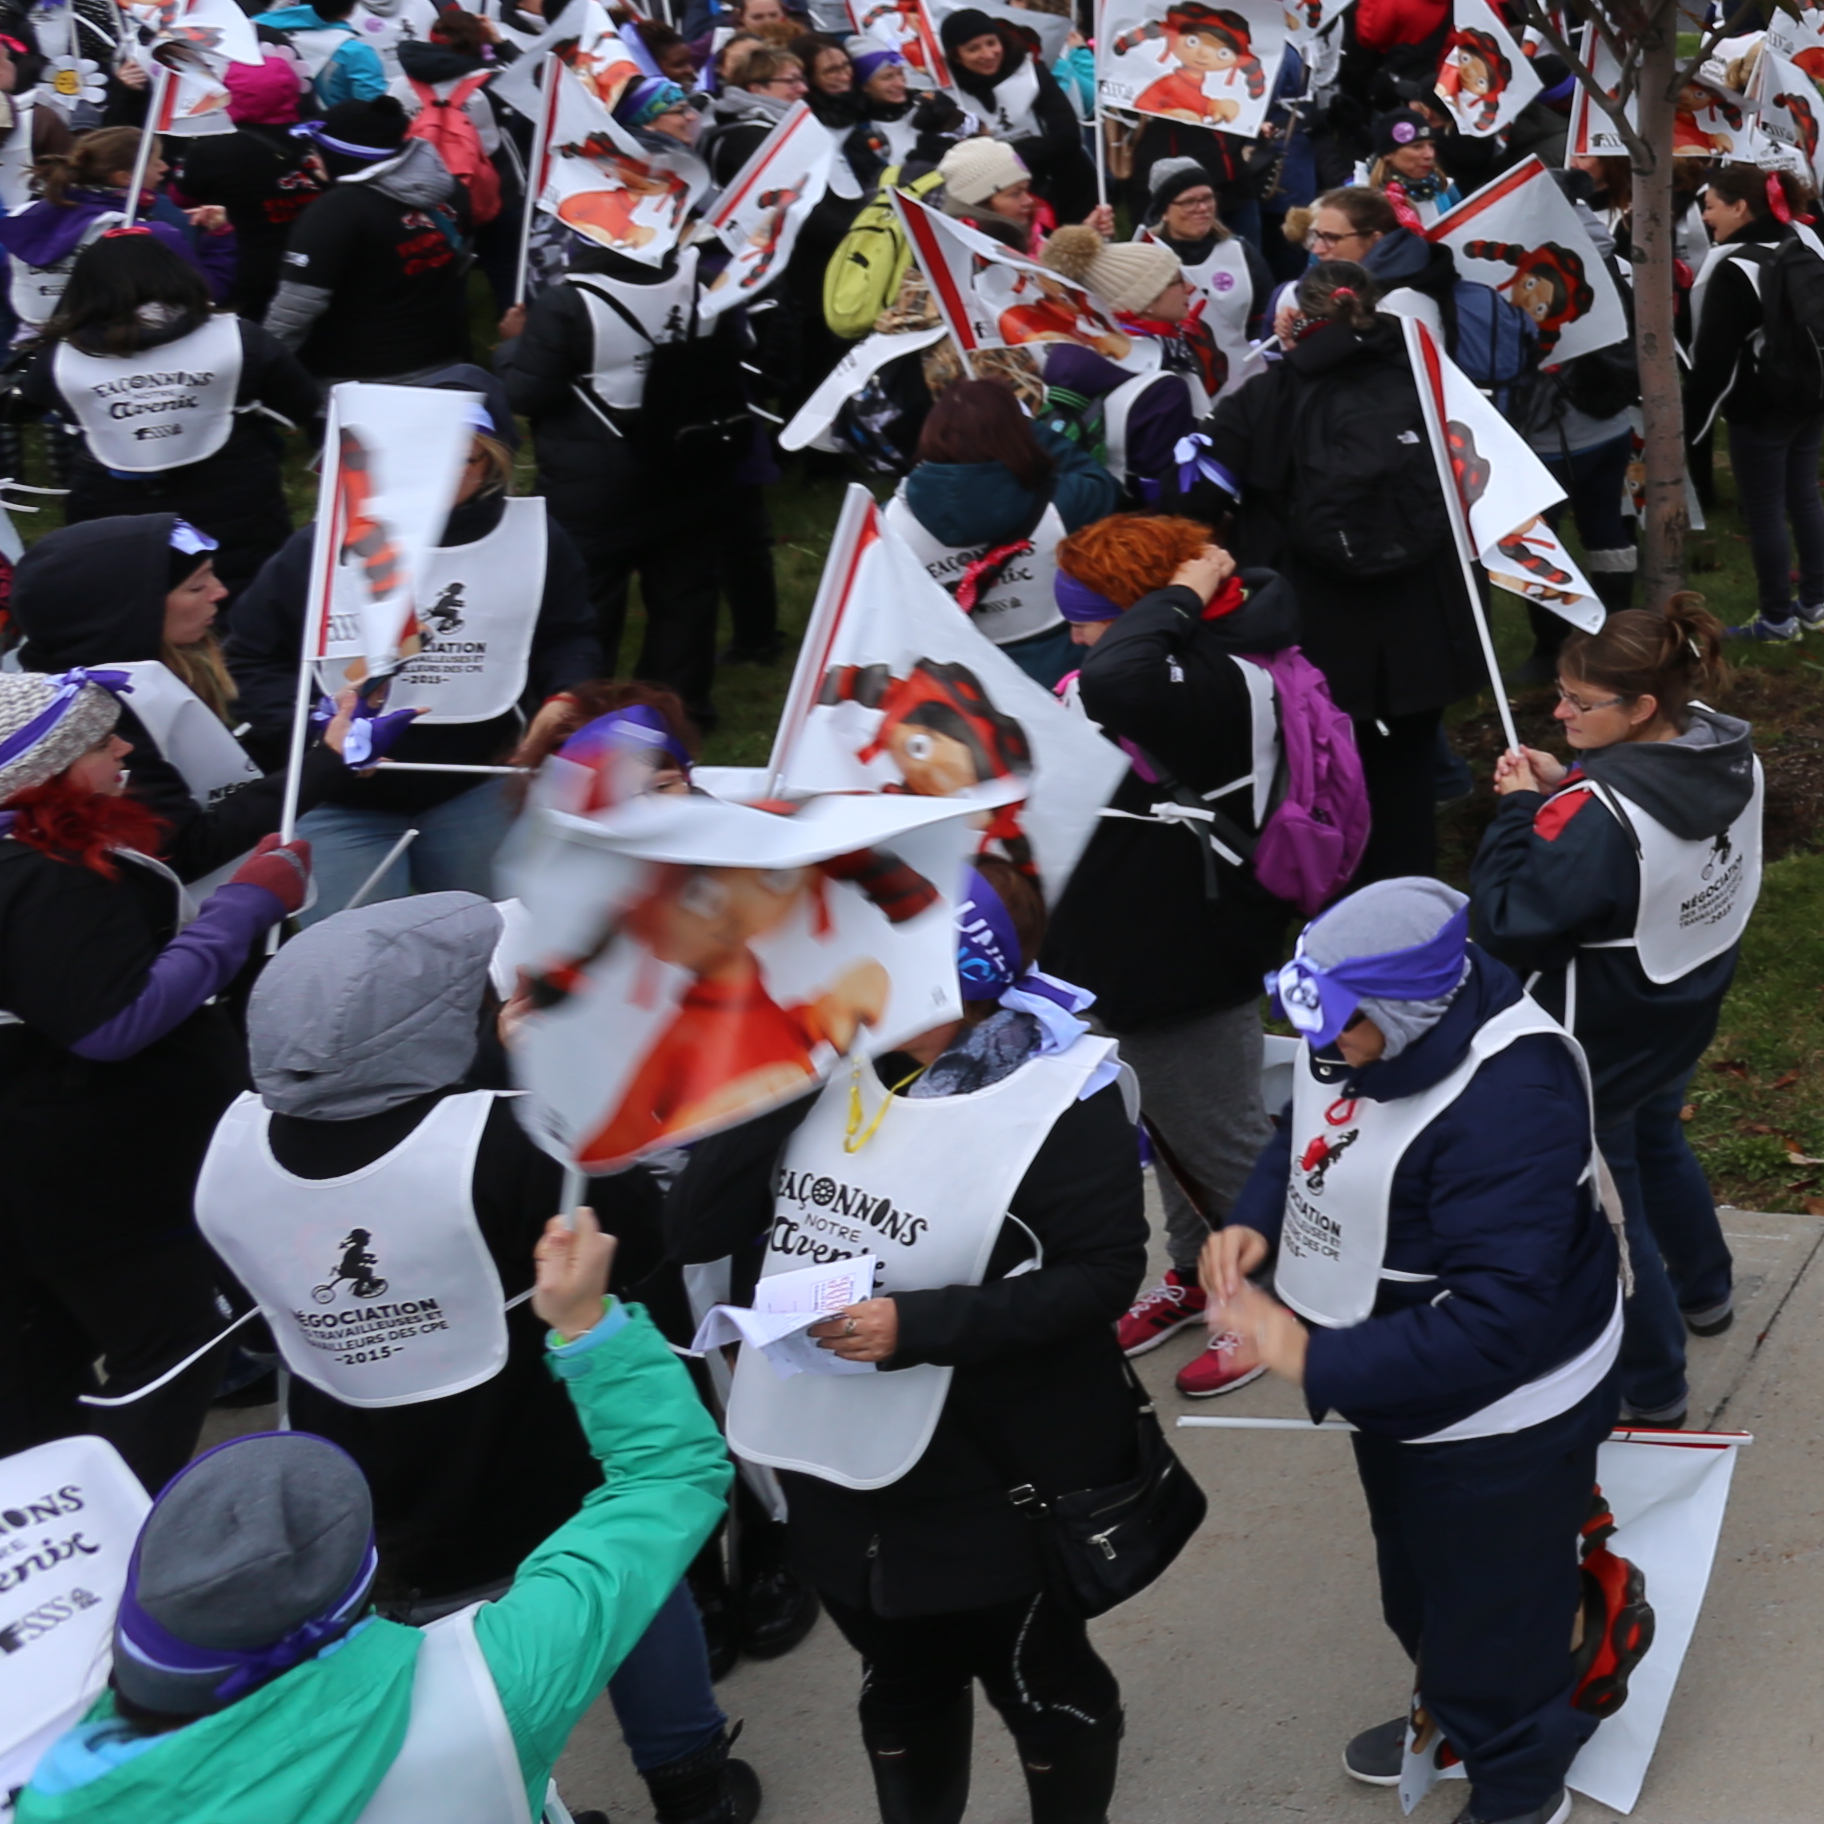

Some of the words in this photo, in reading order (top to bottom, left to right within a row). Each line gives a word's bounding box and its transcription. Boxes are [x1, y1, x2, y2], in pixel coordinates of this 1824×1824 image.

[804, 1213, 861, 1244] NOTRE
[425, 1309, 445, 1320] ET
[388, 1326, 417, 1341] DES
[420, 1319, 450, 1334] CPE
